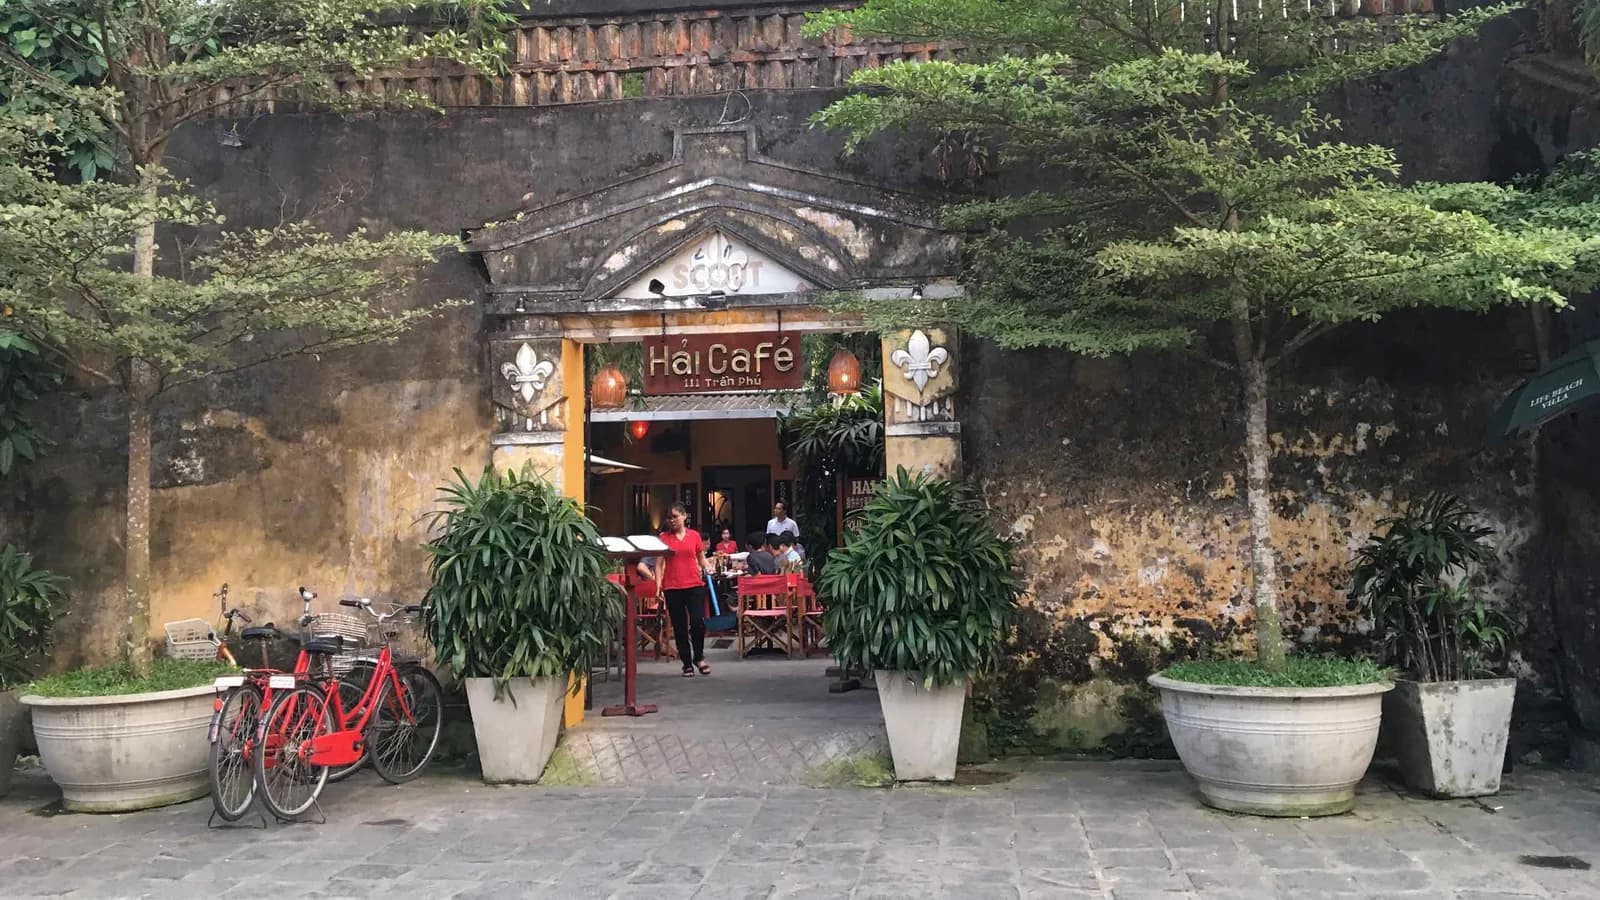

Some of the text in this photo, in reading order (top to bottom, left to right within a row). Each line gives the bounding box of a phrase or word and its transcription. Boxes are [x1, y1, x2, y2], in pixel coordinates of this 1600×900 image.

[649, 336, 794, 377] Hải Café
[738, 374, 761, 387] Phú
[1552, 378, 1583, 398] BEACH
[1541, 393, 1568, 409] VILLA
